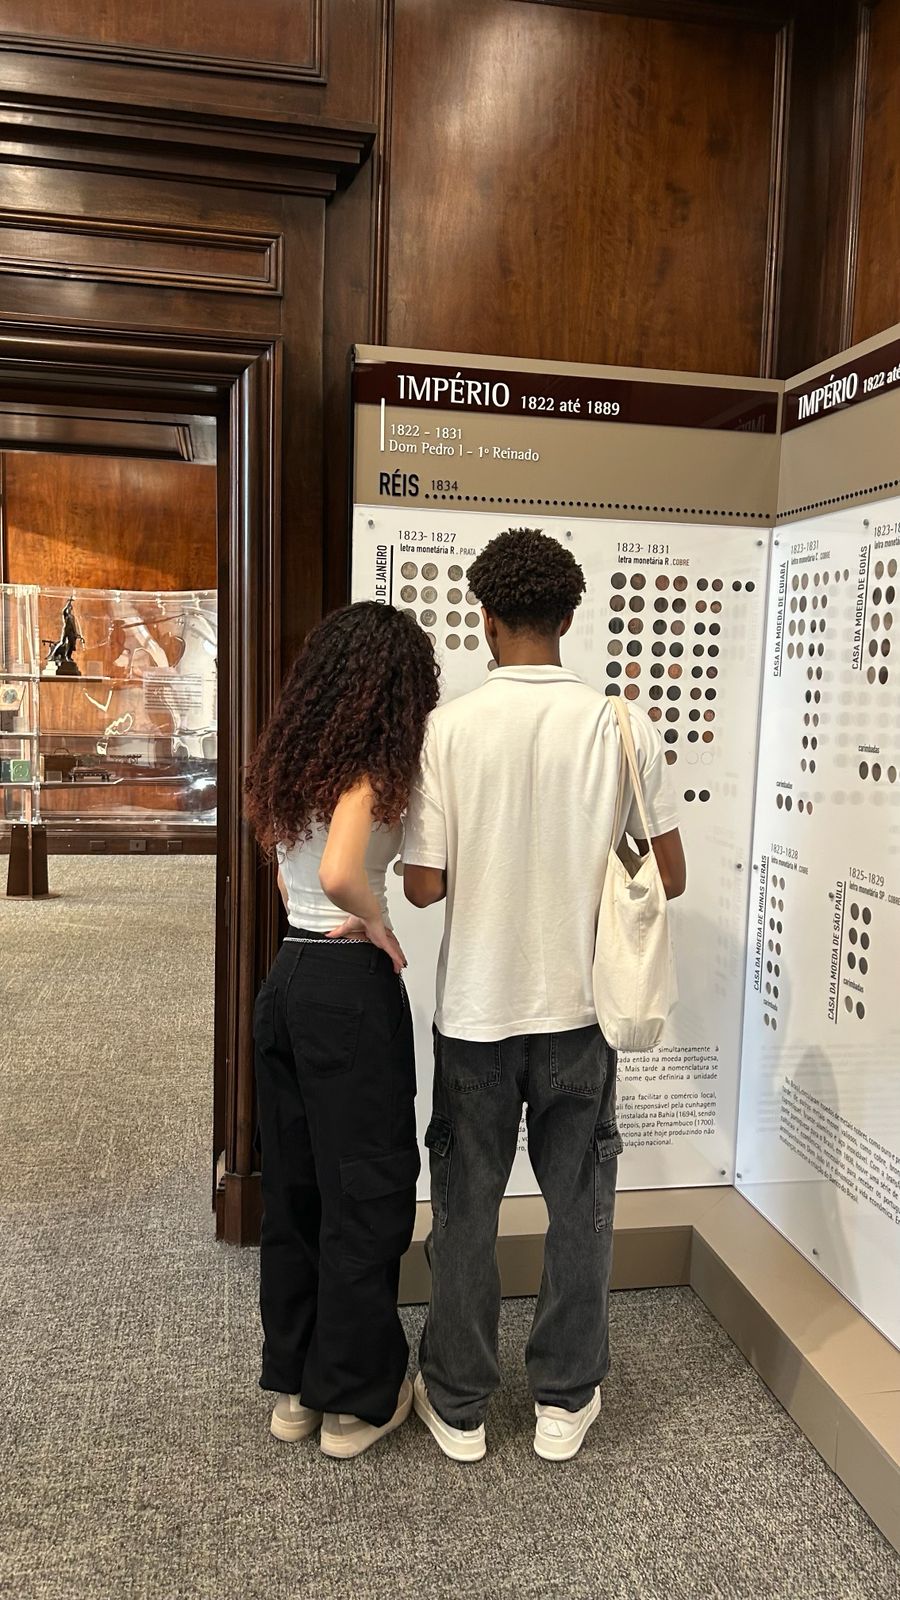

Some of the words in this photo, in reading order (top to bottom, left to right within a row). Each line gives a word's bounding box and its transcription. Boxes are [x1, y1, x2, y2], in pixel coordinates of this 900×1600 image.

[397, 372, 510, 407] IMPÉRIO
[520, 396, 555, 411] 1822
[559, 398, 580, 413] até
[587, 400, 620, 416] 1889
[798, 373, 858, 420] IMPÉRIO
[864, 372, 884, 394] 1822
[390, 424, 420, 437] 1822
[435, 427, 462, 440] 1831
[388, 440, 417, 454] Dom
[422, 442, 454, 456] Pedro
[493, 446, 540, 462] Reinado
[380, 469, 420, 496] RÉIS
[431, 479, 458, 491] 1834
[431, 532, 456, 543] 1827
[874, 522, 900, 537] 1823-18
[400, 543, 414, 552] letra
[416, 545, 448, 554] monetária
[450, 546, 455, 554] R
[460, 548, 476, 556] PRATA
[648, 544, 669, 554] 1831
[376, 545, 387, 582] JANEIRO
[618, 555, 632, 564] letra
[633, 557, 663, 565] monetária
[859, 546, 868, 575] GOIÁS
[376, 585, 386, 596] DE
[858, 577, 865, 589] DE
[856, 592, 864, 628] MOEDA
[775, 640, 781, 653] DA
[778, 596, 784, 607] DE
[854, 629, 861, 642] DA
[852, 645, 860, 670] CASA
[849, 867, 885, 887] 1825-1829
[835, 881, 843, 909] PAULO
[755, 958, 761, 969] DA
[758, 913, 763, 924] DE
[832, 933, 839, 946] DE
[830, 982, 836, 994] DA
[669, 1129, 702, 1137] produzindo
